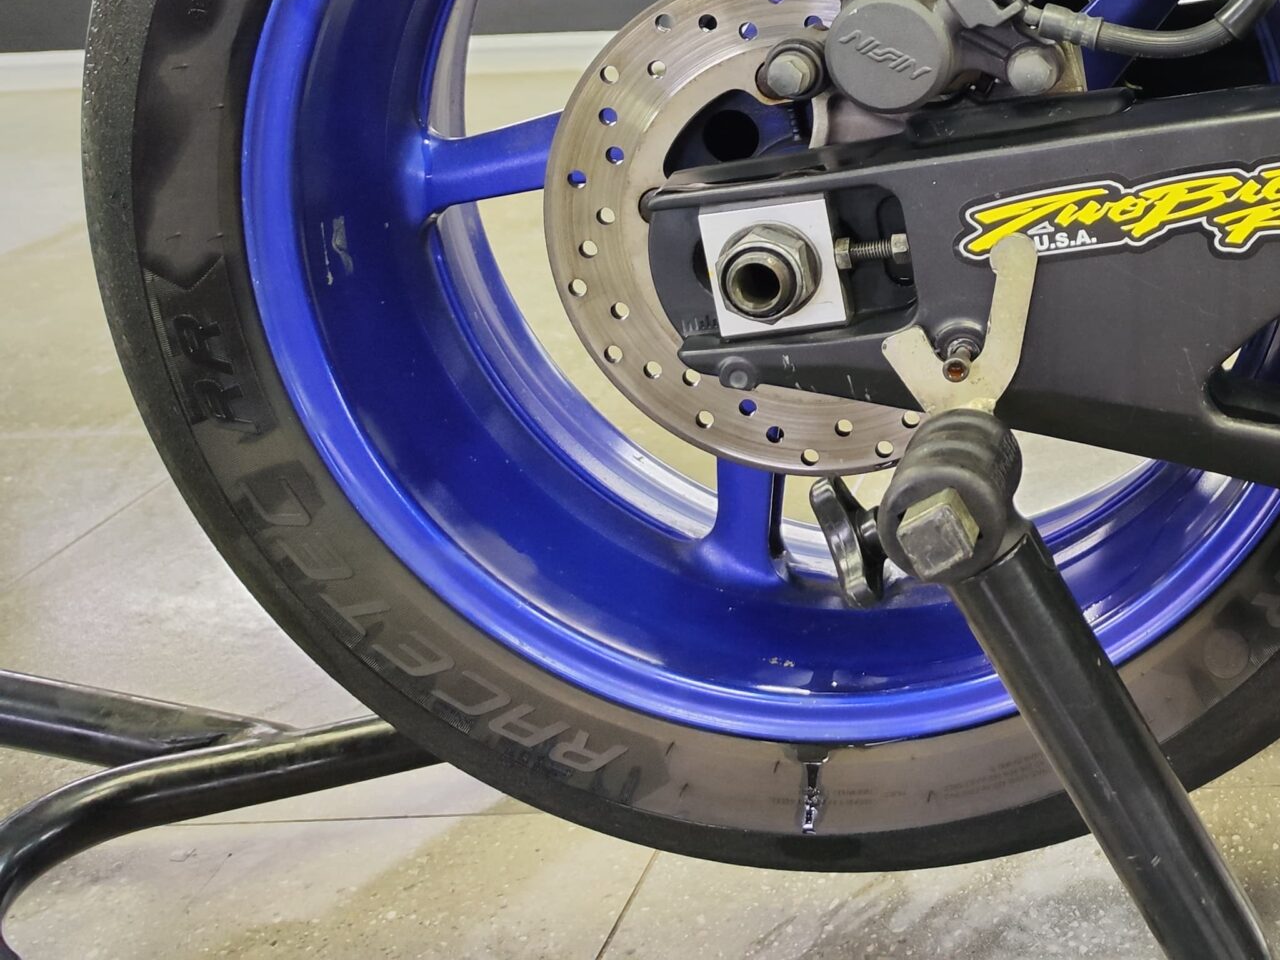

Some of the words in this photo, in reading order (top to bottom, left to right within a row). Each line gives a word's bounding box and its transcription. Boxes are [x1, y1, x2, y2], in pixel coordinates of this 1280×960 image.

[838, 28, 933, 81] NISSIN
[967, 188, 1152, 252] Two
[1033, 229, 1098, 252] U.S.A.
